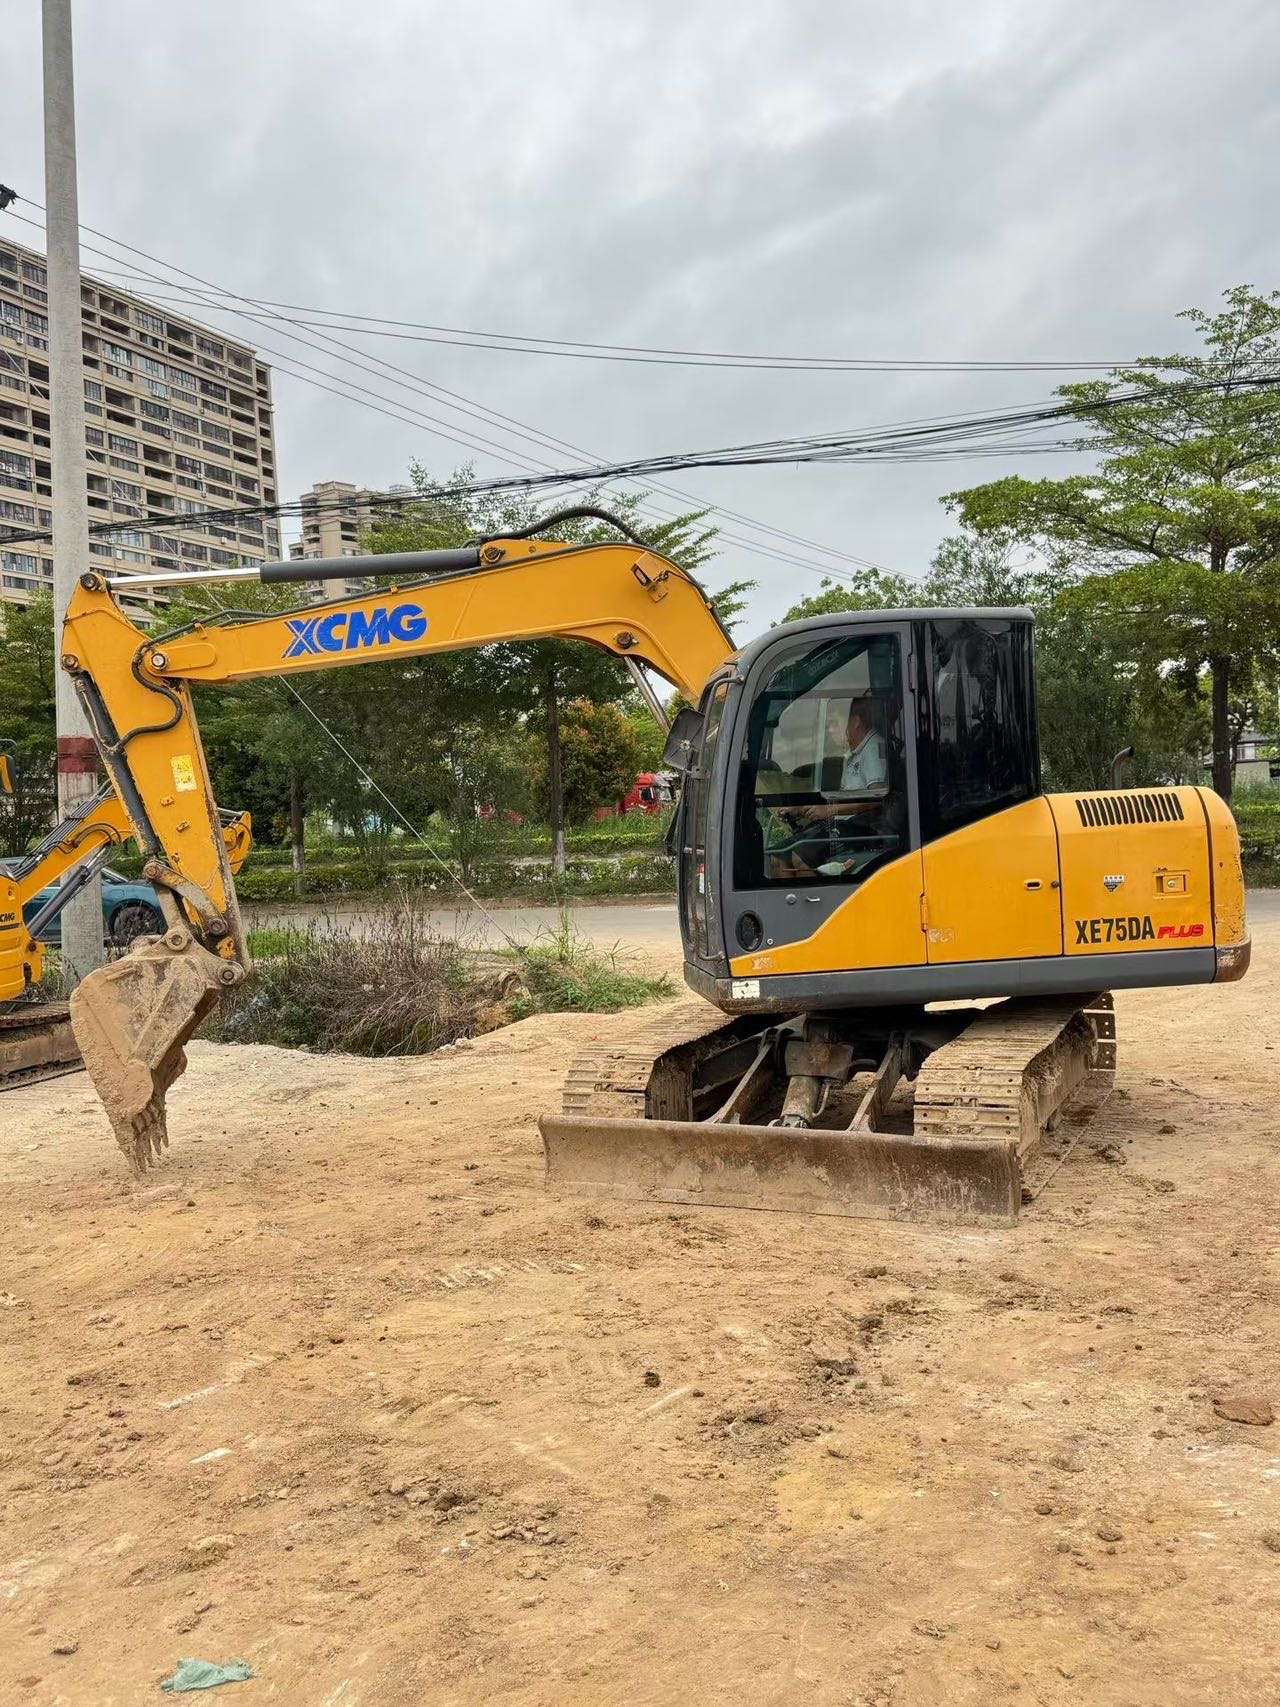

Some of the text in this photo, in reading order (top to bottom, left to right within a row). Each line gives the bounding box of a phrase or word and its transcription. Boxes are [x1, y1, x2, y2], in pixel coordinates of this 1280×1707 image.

[283, 603, 427, 658] XCMG
[1075, 916, 1204, 944] XE75DA PLUS
